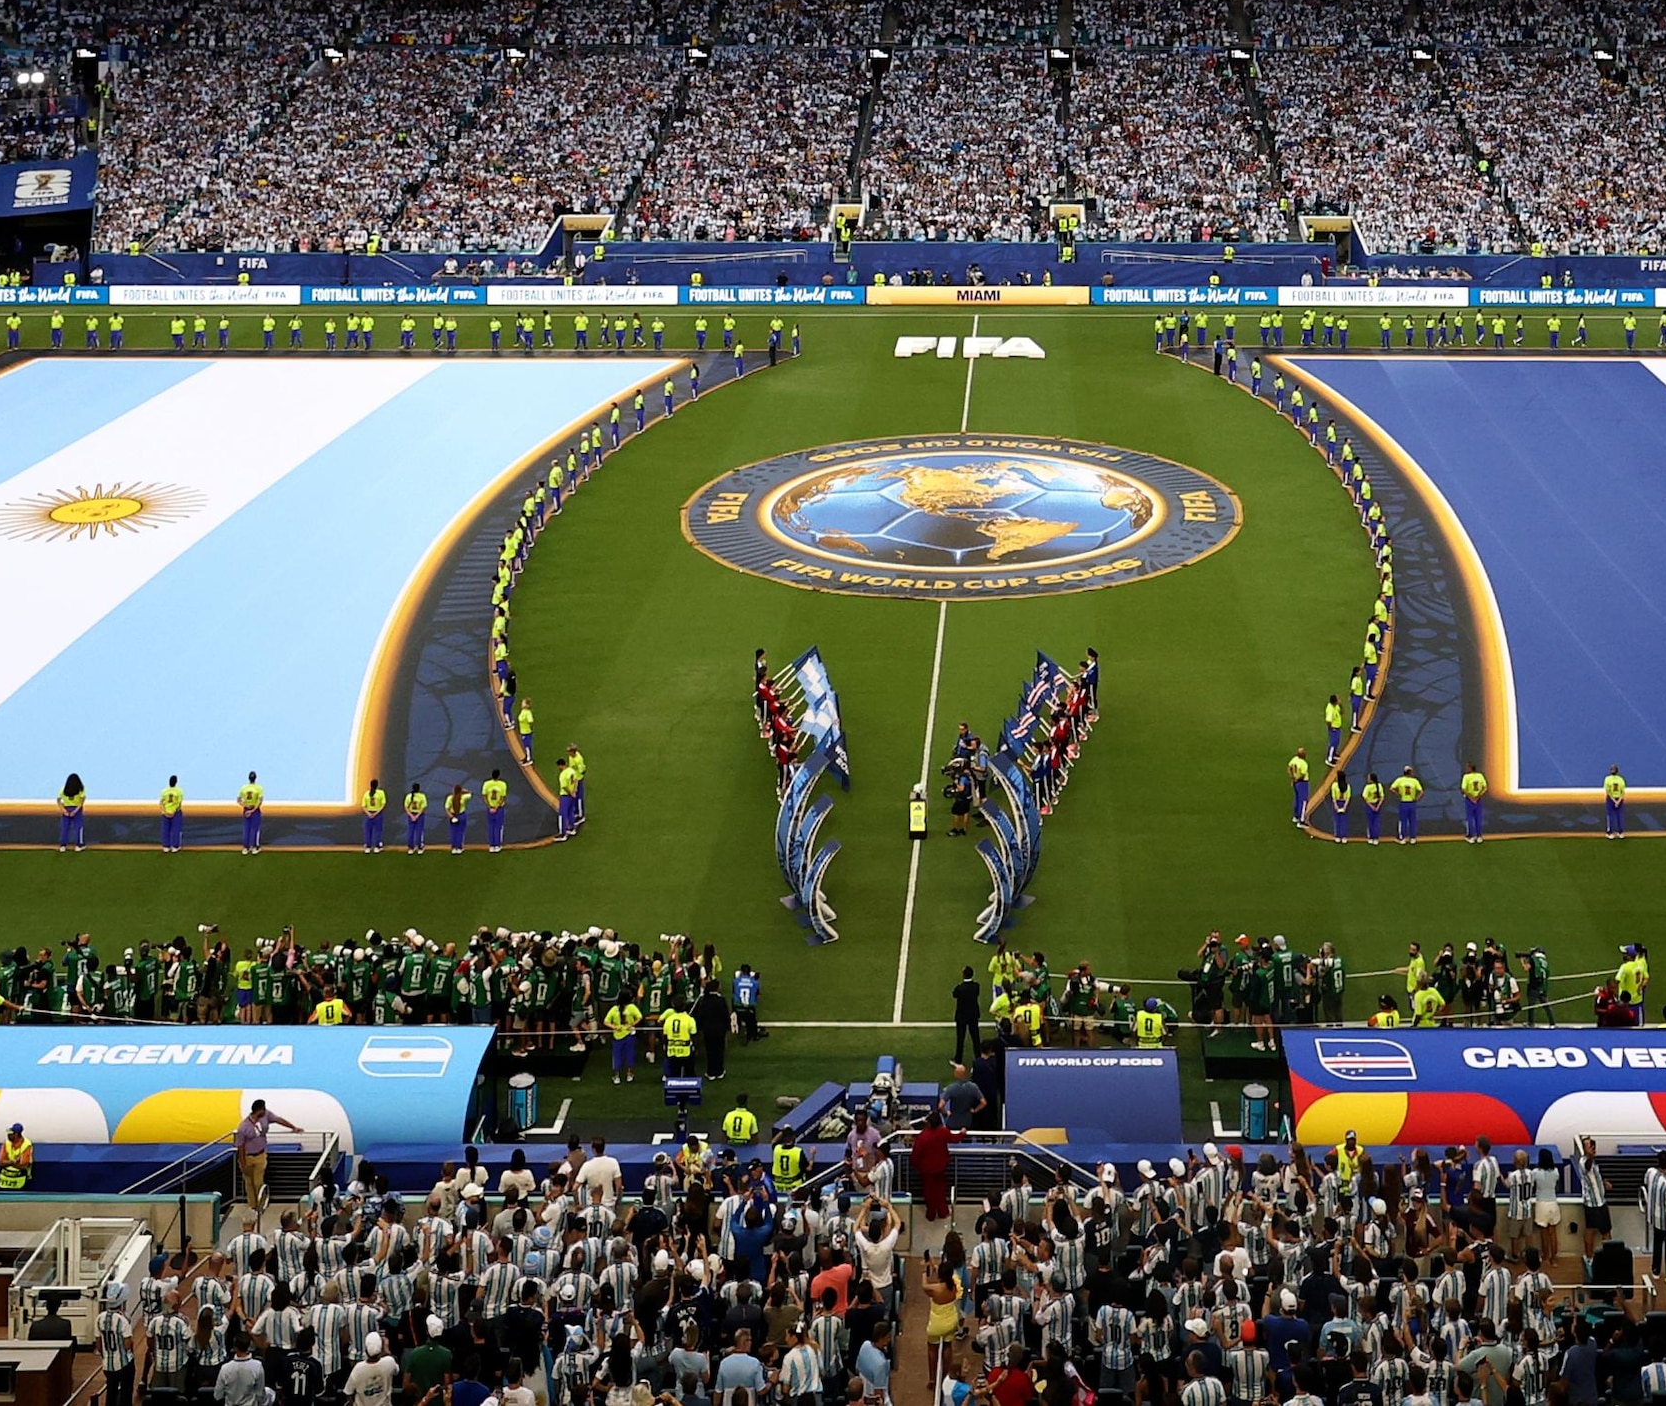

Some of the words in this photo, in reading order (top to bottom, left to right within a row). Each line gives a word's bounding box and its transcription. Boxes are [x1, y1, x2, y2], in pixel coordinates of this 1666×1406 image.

[238, 257, 267, 270] FIFA
[18, 286, 37, 303] the
[37, 286, 71, 304] World
[76, 291, 99, 300] FIFA
[311, 288, 358, 302] FOOTBALL
[361, 288, 394, 302] UNITES
[396, 287, 412, 302] the
[413, 287, 449, 304] World
[454, 291, 476, 300] FIFA
[688, 289, 736, 302] FOOTBALL
[738, 289, 772, 302] UNITES
[774, 287, 790, 302] the
[791, 287, 826, 305] World
[830, 291, 854, 300] FIFA
[956, 289, 1001, 302] MIAMI
[1103, 289, 1151, 303] FOOTBALL
[1153, 289, 1186, 303] UNITES
[1187, 288, 1206, 303] the
[1206, 288, 1240, 305] World
[1244, 292, 1269, 301] FIFA
[1292, 290, 1338, 303] FOOTBALL
[1341, 290, 1374, 303] UNITES
[1378, 289, 1395, 303] the
[1396, 289, 1428, 305] World
[1434, 293, 1455, 301] FIFA
[1479, 290, 1528, 304] FOOTBALL
[1529, 290, 1563, 304] UNITES
[1564, 289, 1583, 305] the
[1583, 289, 1617, 307] World
[1621, 293, 1645, 303] FIFA
[893, 335, 1046, 359] FIFA
[906, 438, 961, 450] CUP
[707, 492, 749, 524] FIFA
[1176, 490, 1217, 522] FIFA
[770, 557, 833, 580] FIFA
[840, 572, 957, 591] WORLD
[966, 575, 1032, 590] CUP
[1034, 556, 1144, 585] 2026
[37, 1044, 294, 1066] ARGENTINA
[1018, 1057, 1044, 1066] FIFA
[1045, 1057, 1091, 1067] WORLD
[1093, 1057, 1118, 1067] CUP
[1119, 1057, 1163, 1067] 2026
[1462, 1047, 1588, 1070] CABO
